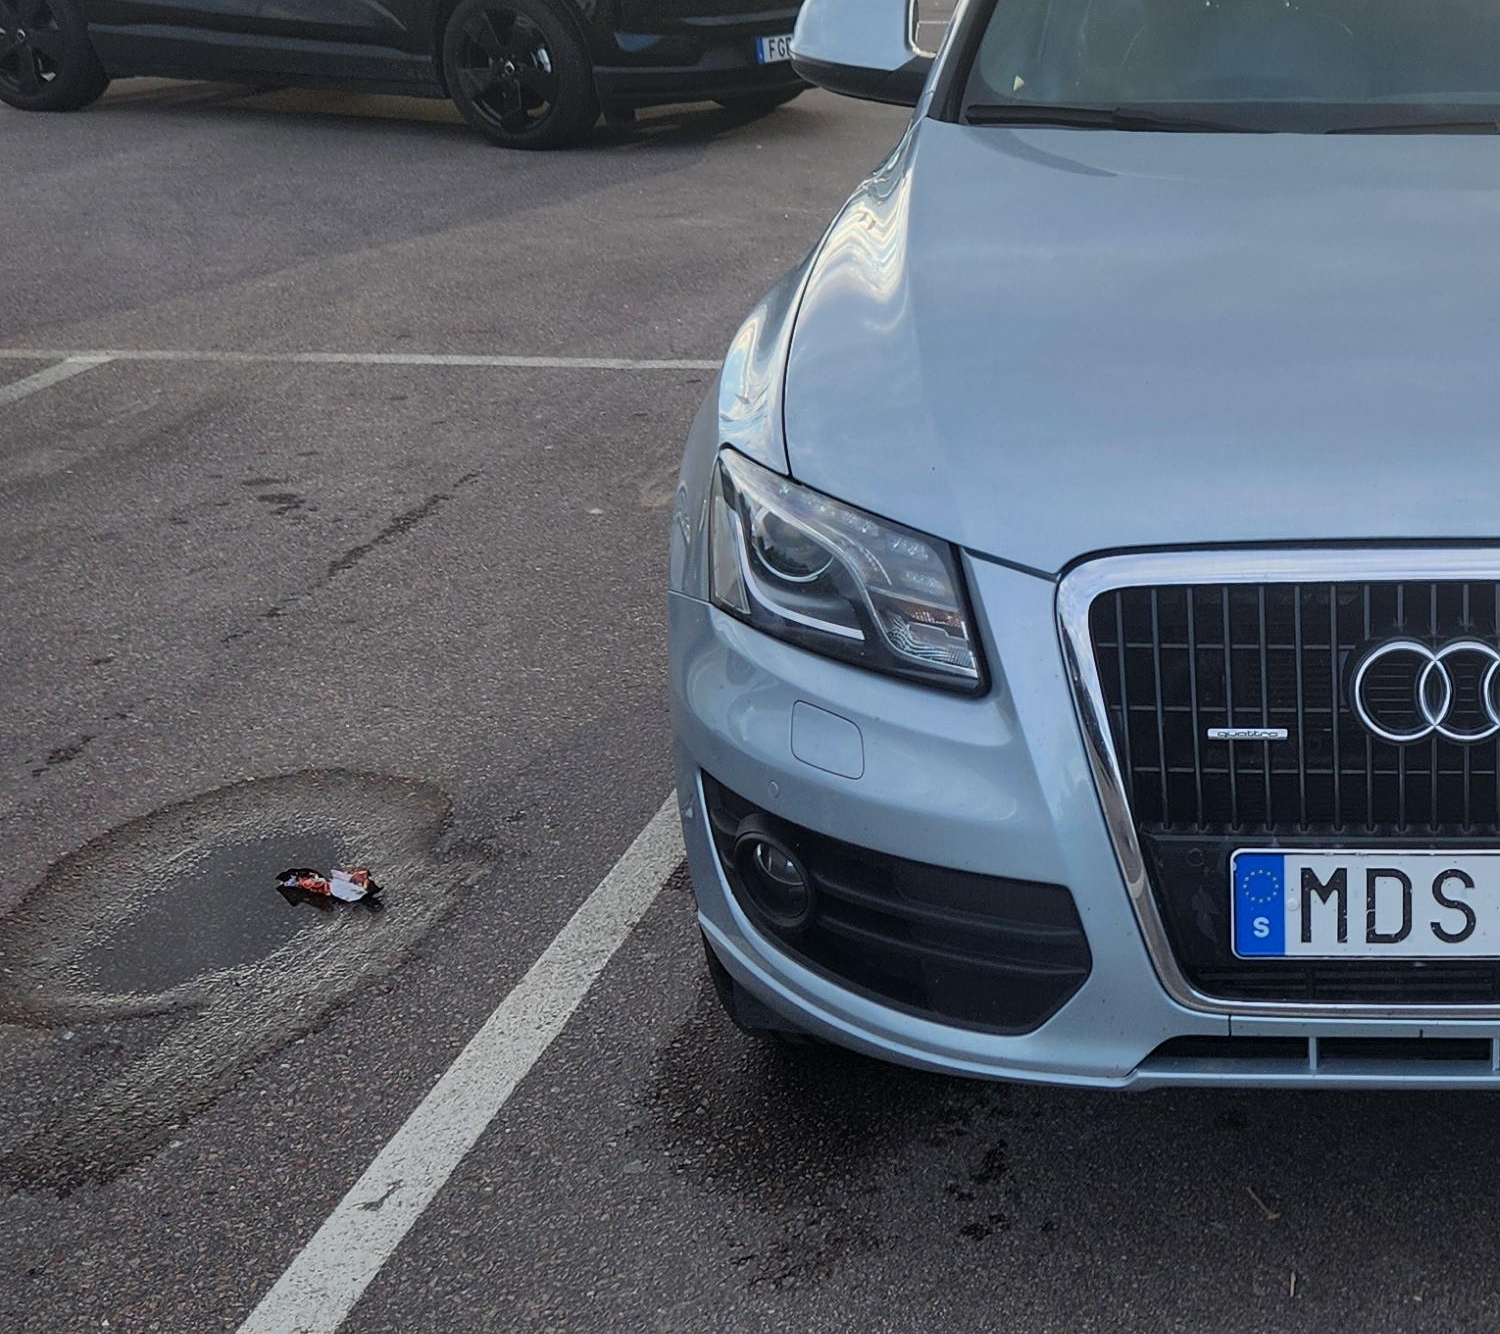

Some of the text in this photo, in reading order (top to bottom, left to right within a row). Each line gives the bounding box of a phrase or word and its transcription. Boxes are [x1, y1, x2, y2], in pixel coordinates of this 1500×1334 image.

[1217, 730, 1279, 739] quattro
[1300, 866, 1477, 945] MDS
[1253, 916, 1270, 938] S
